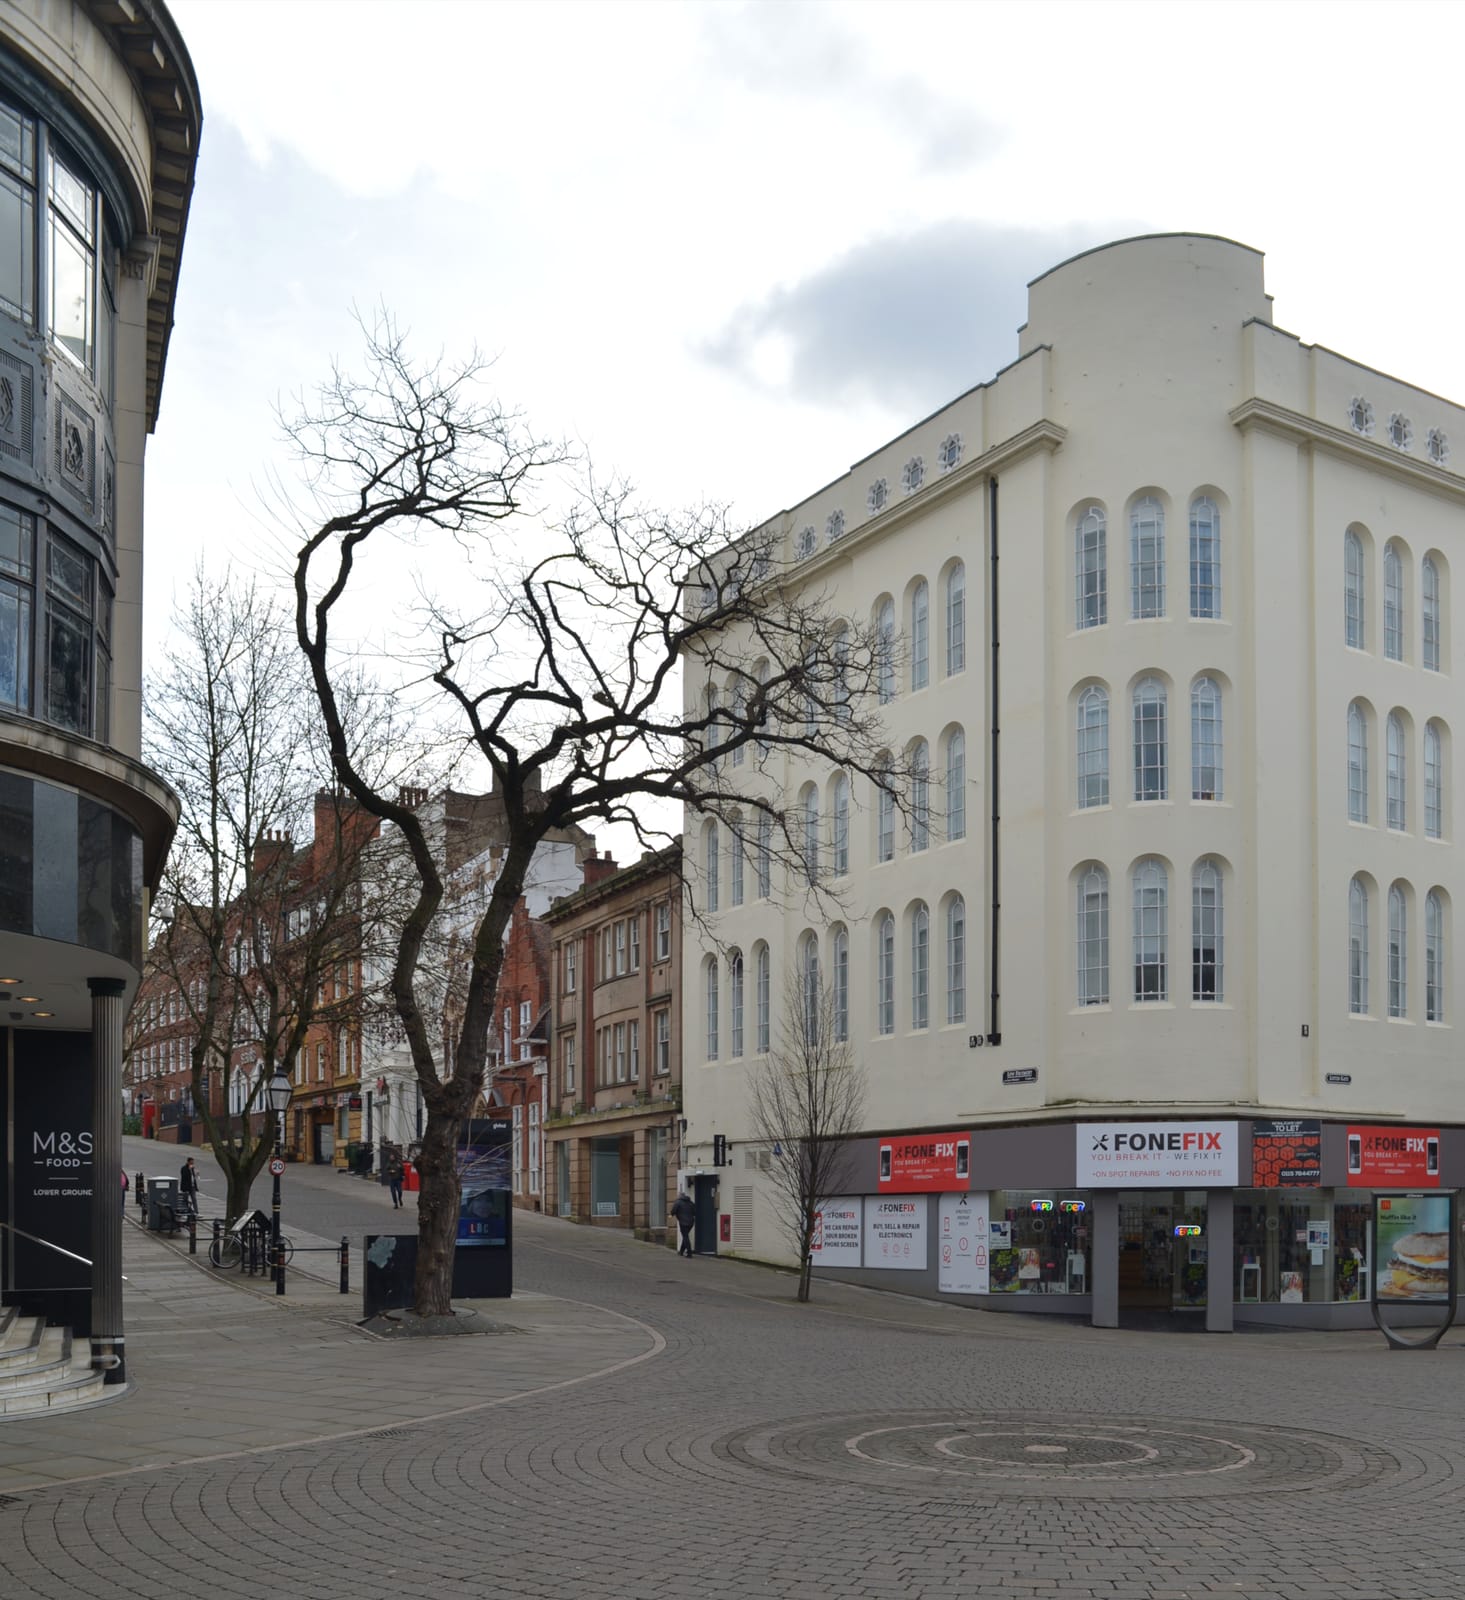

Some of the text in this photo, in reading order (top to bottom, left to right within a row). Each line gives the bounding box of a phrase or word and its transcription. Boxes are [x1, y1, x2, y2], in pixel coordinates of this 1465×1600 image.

[34, 1131, 93, 1155] M&S
[1114, 1132, 1222, 1151] FONEFIX
[1375, 1137, 1425, 1152] FONEFIX
[905, 1143, 955, 1158] FONEFIX
[1091, 1153, 1111, 1161] YOU
[1116, 1153, 1149, 1161] BREAK
[1152, 1153, 1162, 1161] IT
[1213, 1152, 1222, 1160] IT
[47, 1158, 81, 1167] FOOD
[884, 1203, 915, 1212] FONEFIX
[1031, 1202, 1050, 1211] VAPE
